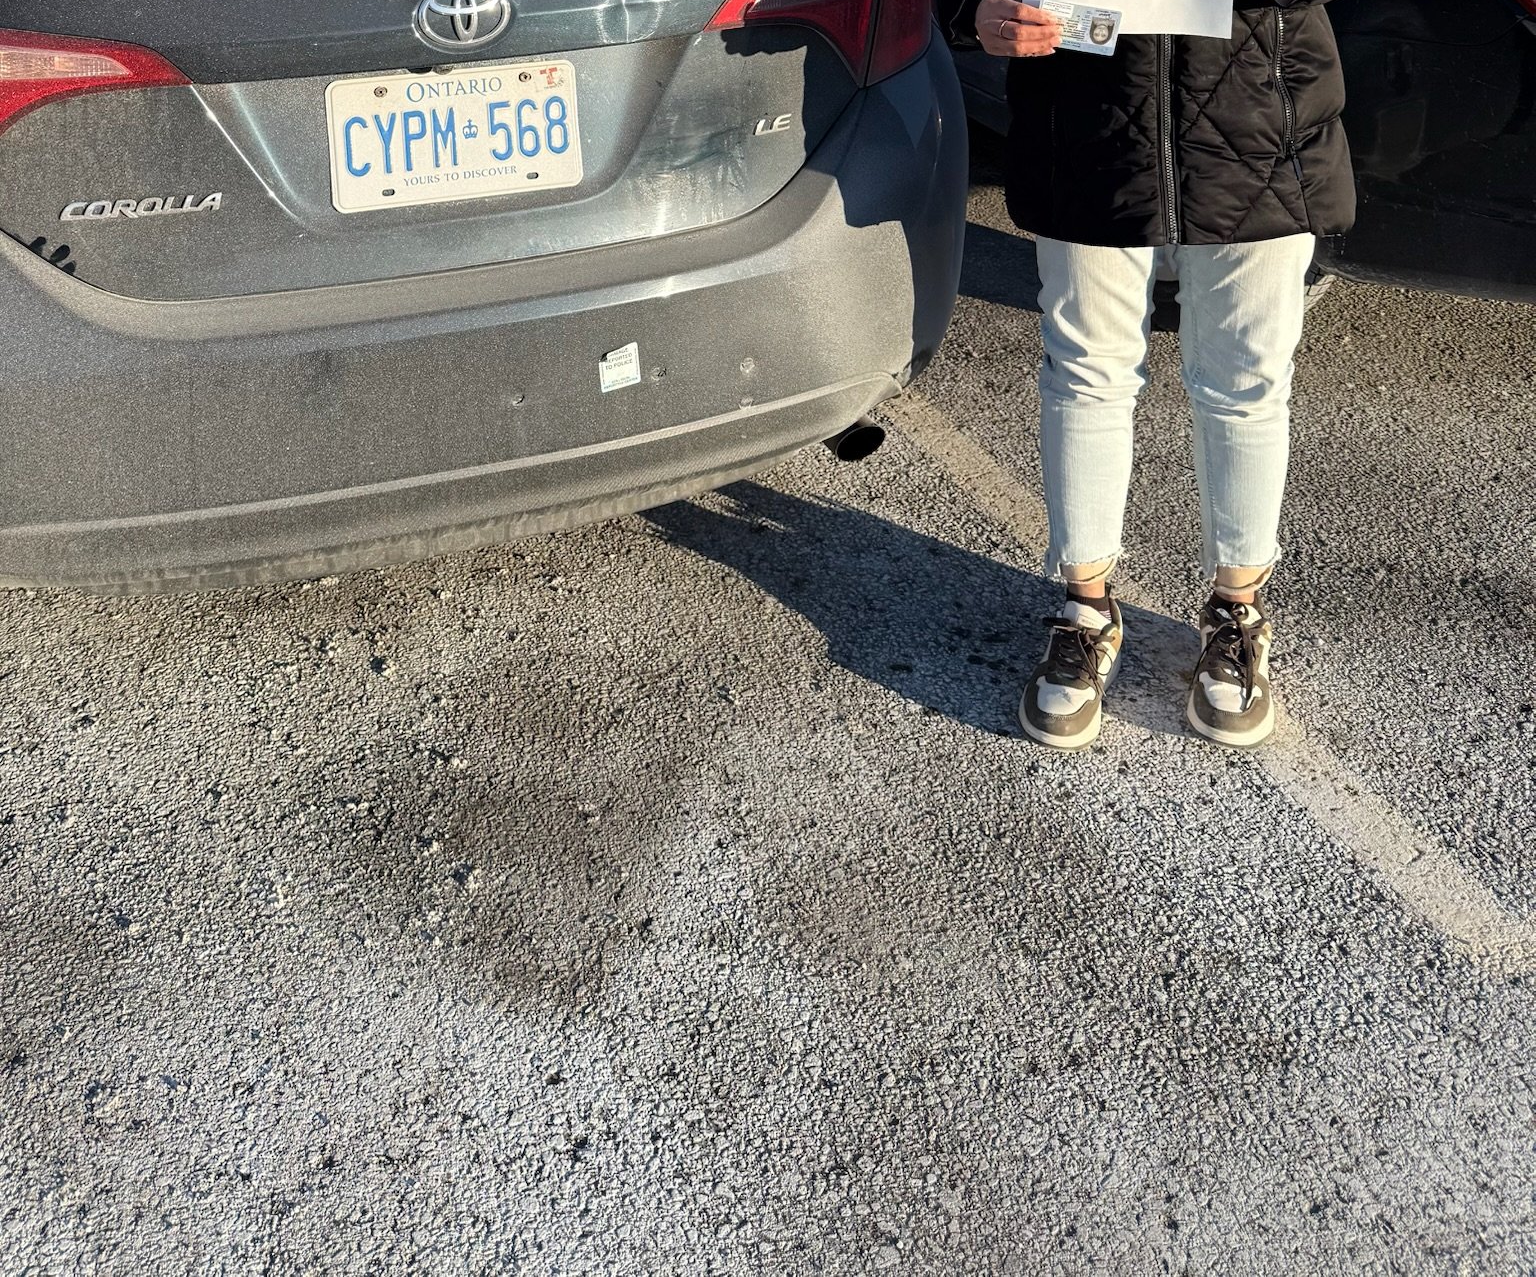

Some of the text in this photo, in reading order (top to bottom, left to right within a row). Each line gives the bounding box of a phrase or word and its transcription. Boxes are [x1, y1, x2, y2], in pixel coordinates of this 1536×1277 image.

[406, 77, 502, 103] ONTARIO
[344, 95, 571, 177] CYPM 568
[754, 113, 792, 136] LE
[404, 165, 518, 187] YOURS TO DISCOVER
[60, 192, 223, 221] COROLLA
